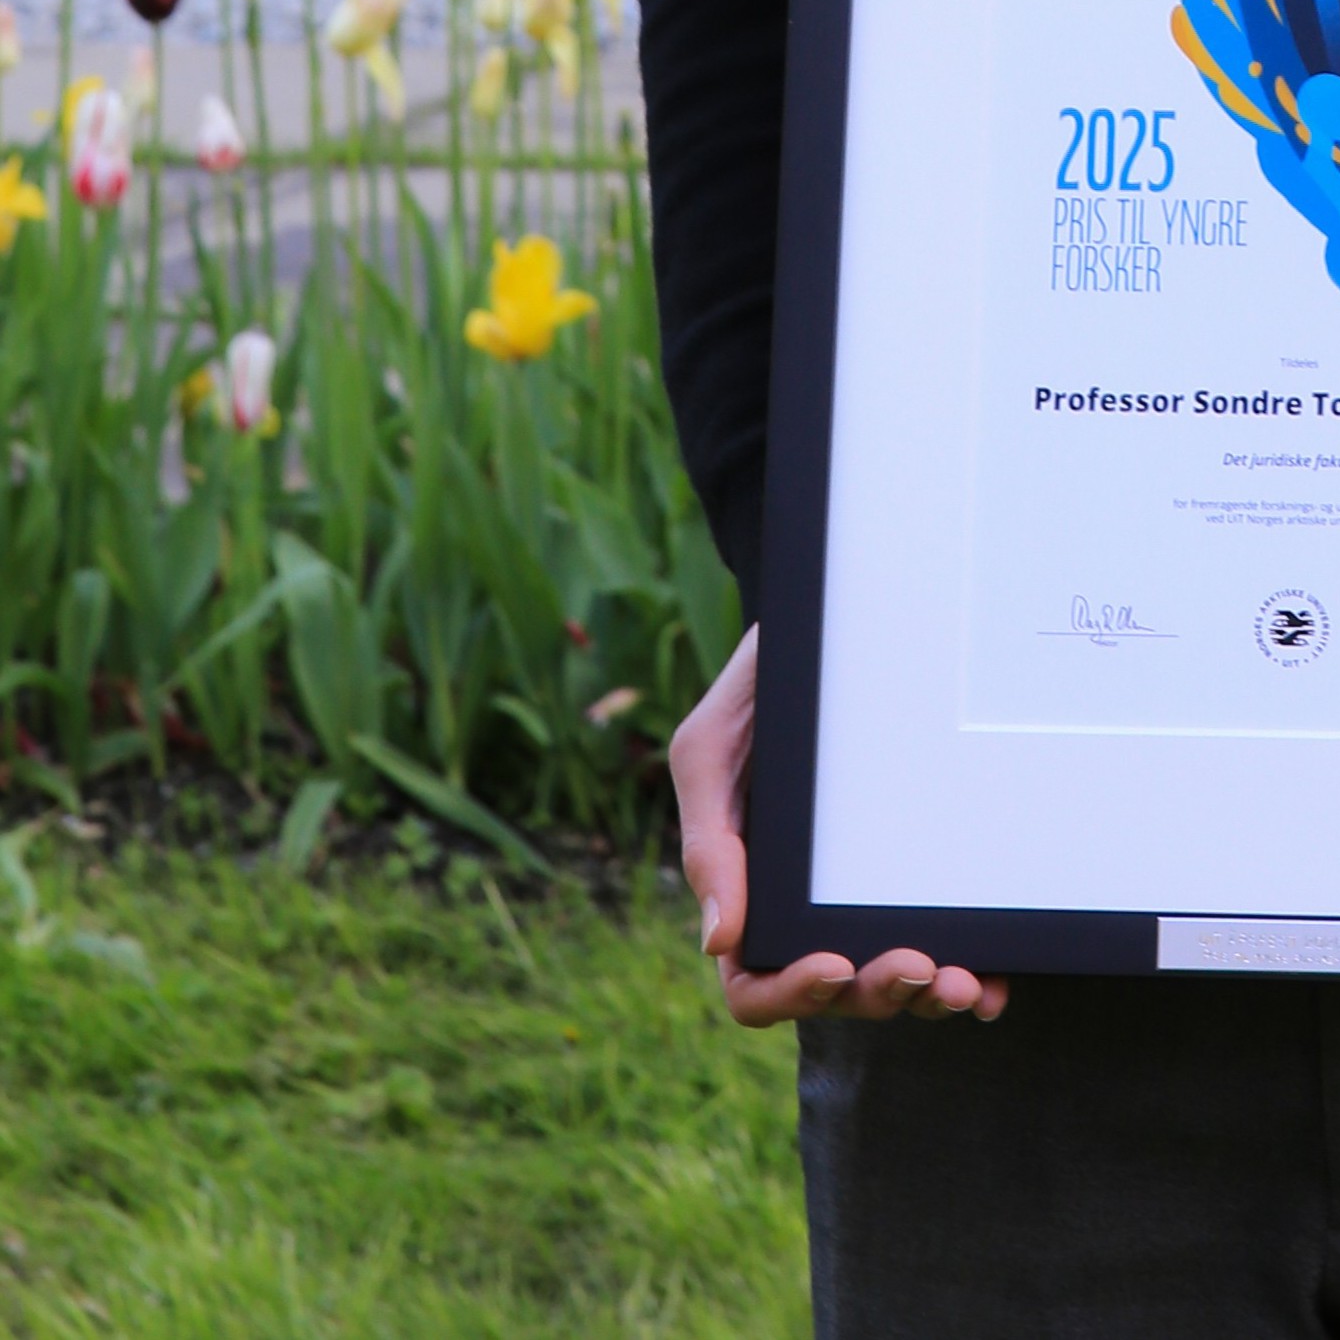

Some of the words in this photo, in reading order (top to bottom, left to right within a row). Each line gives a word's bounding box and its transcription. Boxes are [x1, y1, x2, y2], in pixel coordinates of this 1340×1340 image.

[1056, 107, 1176, 192] 2025
[1053, 197, 1107, 244] PRIS
[1116, 198, 1150, 245] TIL
[1162, 200, 1248, 247] YNGRE
[1051, 244, 1162, 292] FORSKER
[1035, 387, 1184, 413] Professor
[1193, 389, 1302, 416] Sondre
[1222, 452, 1248, 467] Det
[1248, 453, 1312, 470] juridiske
